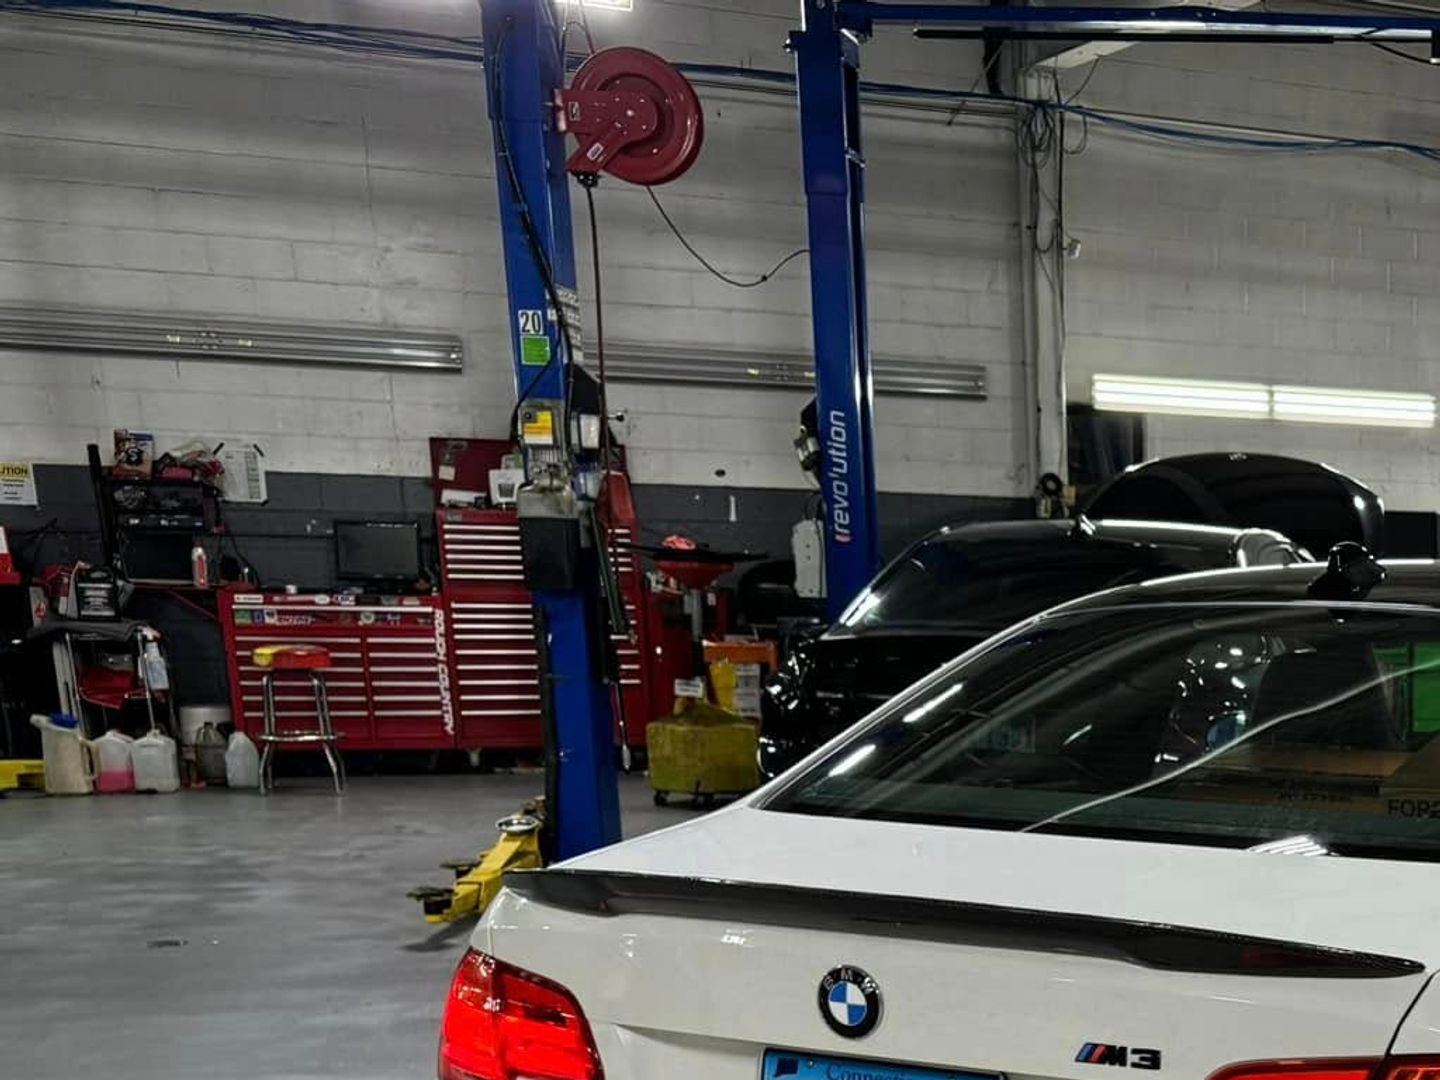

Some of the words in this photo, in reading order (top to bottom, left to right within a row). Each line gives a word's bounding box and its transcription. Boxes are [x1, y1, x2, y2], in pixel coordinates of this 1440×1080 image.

[519, 312, 542, 334] 20
[823, 967, 875, 995] BMW
[1092, 1044, 1162, 1070] M3
